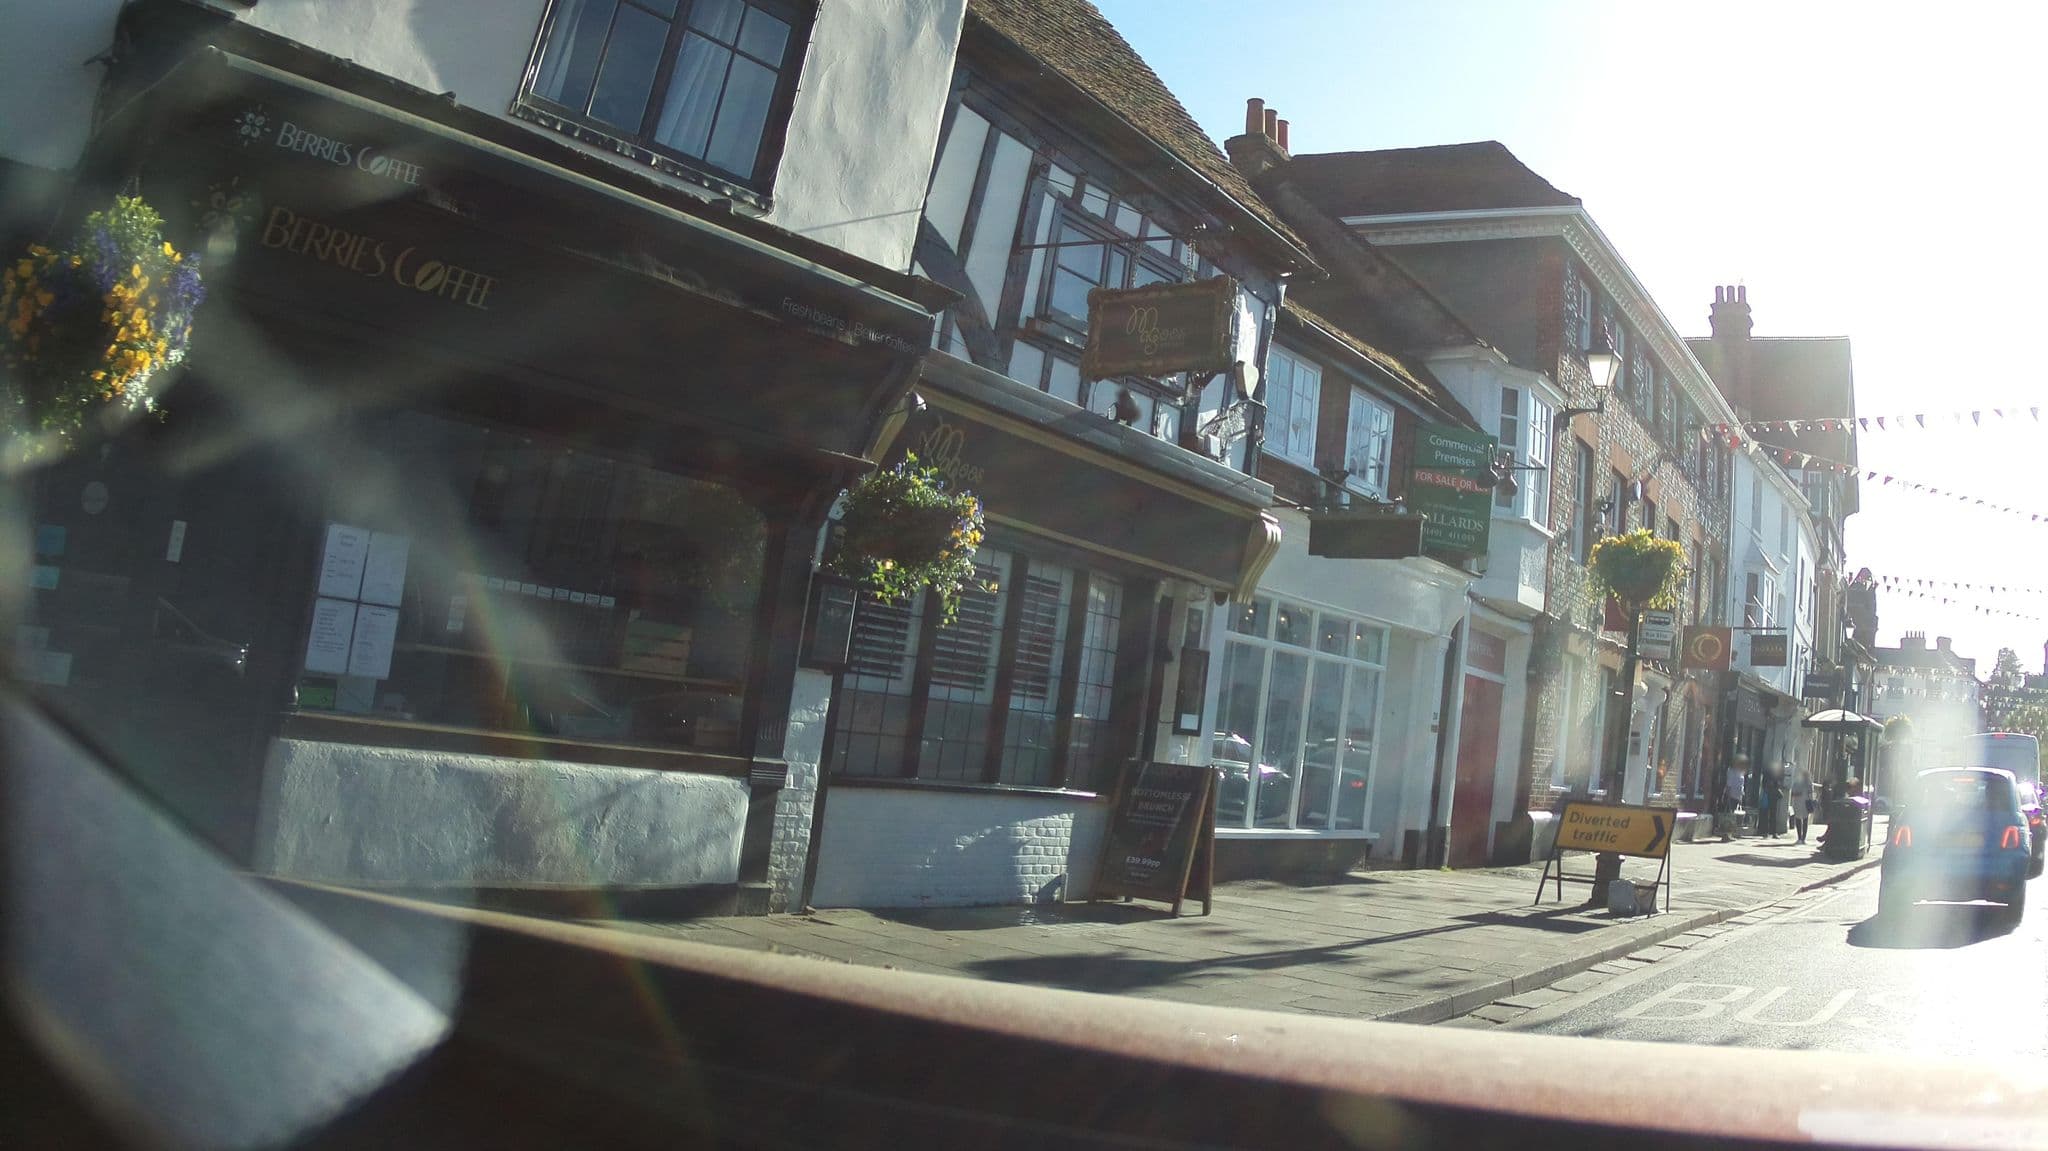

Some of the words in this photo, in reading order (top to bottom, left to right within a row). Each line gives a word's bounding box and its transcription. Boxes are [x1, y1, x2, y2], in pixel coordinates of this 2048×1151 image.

[357, 146, 424, 186] COFFEE
[394, 247, 497, 311] COFFEE
[782, 297, 813, 320] Fresh
[1429, 434, 1485, 454] Commercial
[1434, 450, 1477, 467] Premises
[1415, 470, 1433, 483] FOR
[1435, 473, 1457, 488] SALE
[1460, 479, 1472, 491] OR
[1569, 811, 1631, 829] Diverted
[1573, 829, 1617, 843] traffic
